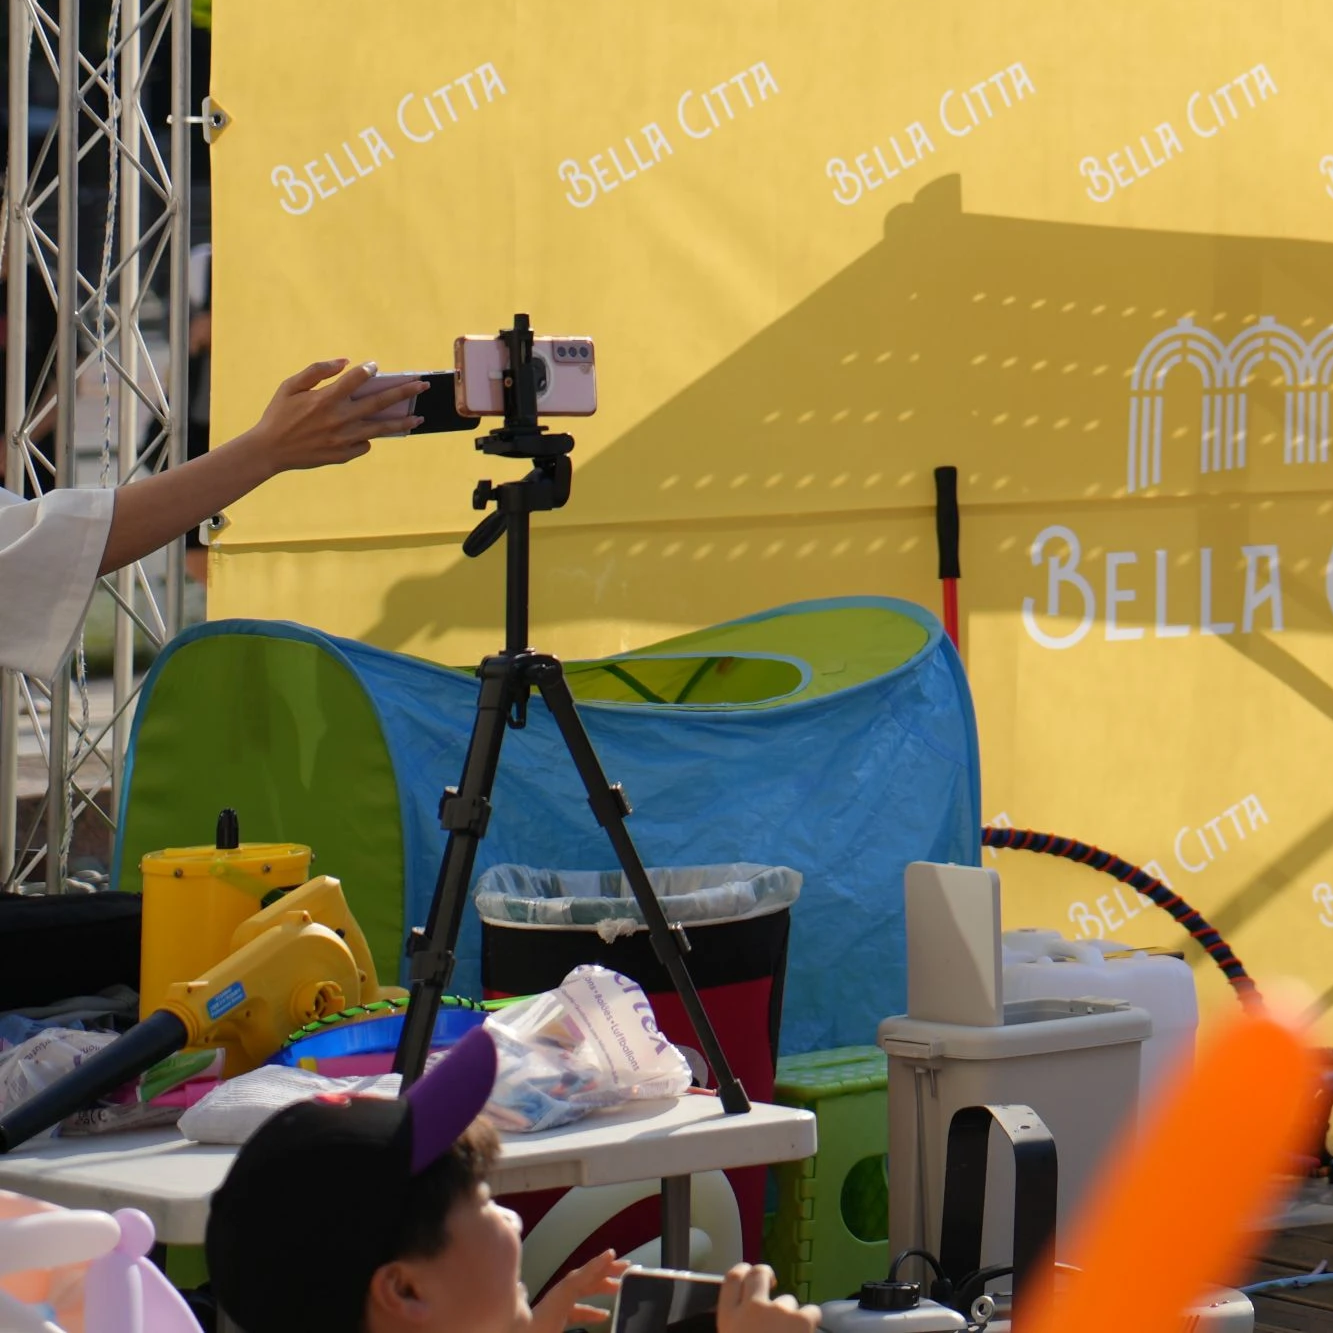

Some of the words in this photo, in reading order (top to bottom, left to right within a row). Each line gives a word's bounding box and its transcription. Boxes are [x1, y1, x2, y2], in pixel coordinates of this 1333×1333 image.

[270, 126, 395, 215] BELLA
[396, 61, 507, 143] CITTA
[558, 122, 673, 209] BELLA
[676, 61, 781, 139] CITTA
[826, 119, 936, 206] BELLA
[938, 61, 1037, 137] CITTA
[1079, 121, 1184, 203] BELLA
[1186, 62, 1279, 137] CITTA
[1022, 524, 1284, 650] BELLA
[1173, 792, 1271, 873] CITTA
